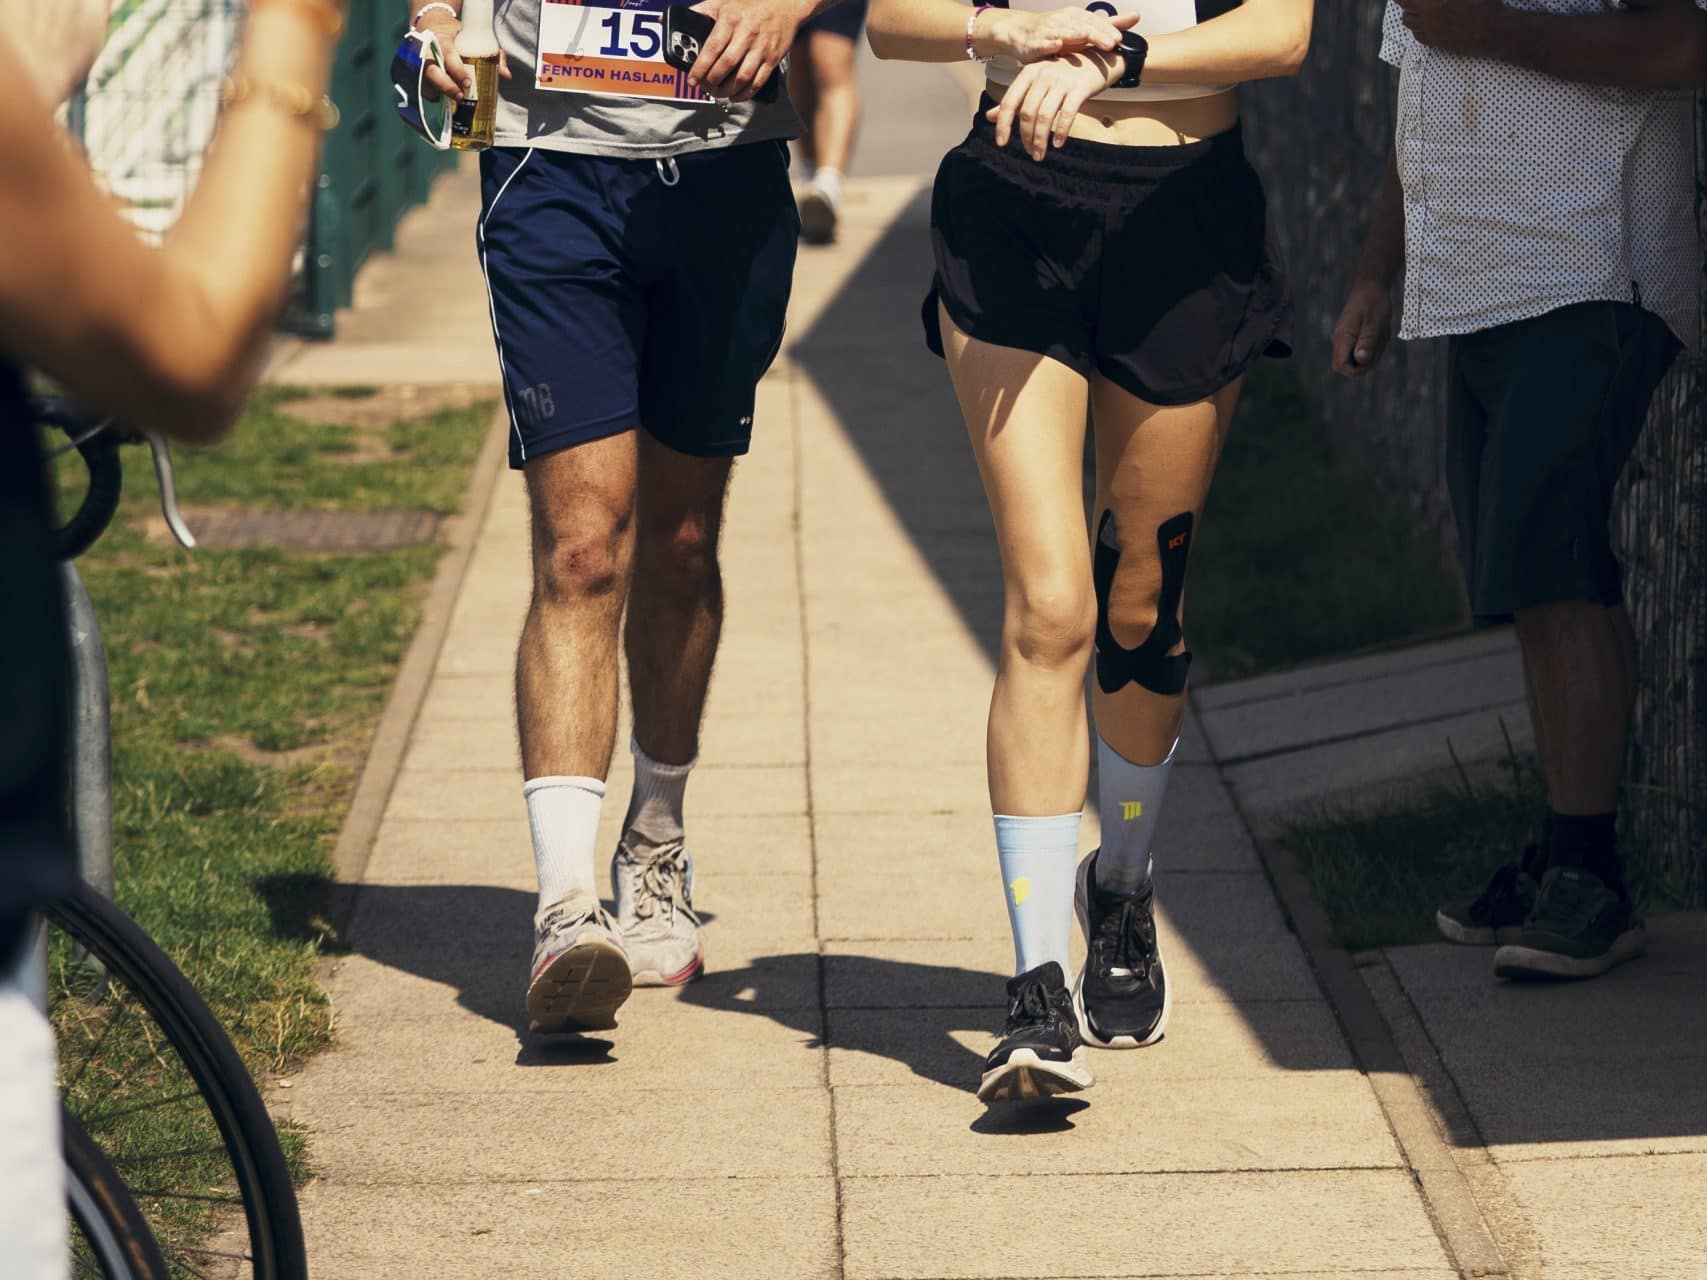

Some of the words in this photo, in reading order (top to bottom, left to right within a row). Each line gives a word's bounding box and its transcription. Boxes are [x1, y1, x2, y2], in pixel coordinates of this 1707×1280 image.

[600, 11, 661, 58] 15
[542, 63, 606, 80] FENTON
[610, 68, 675, 85] HASLAM
